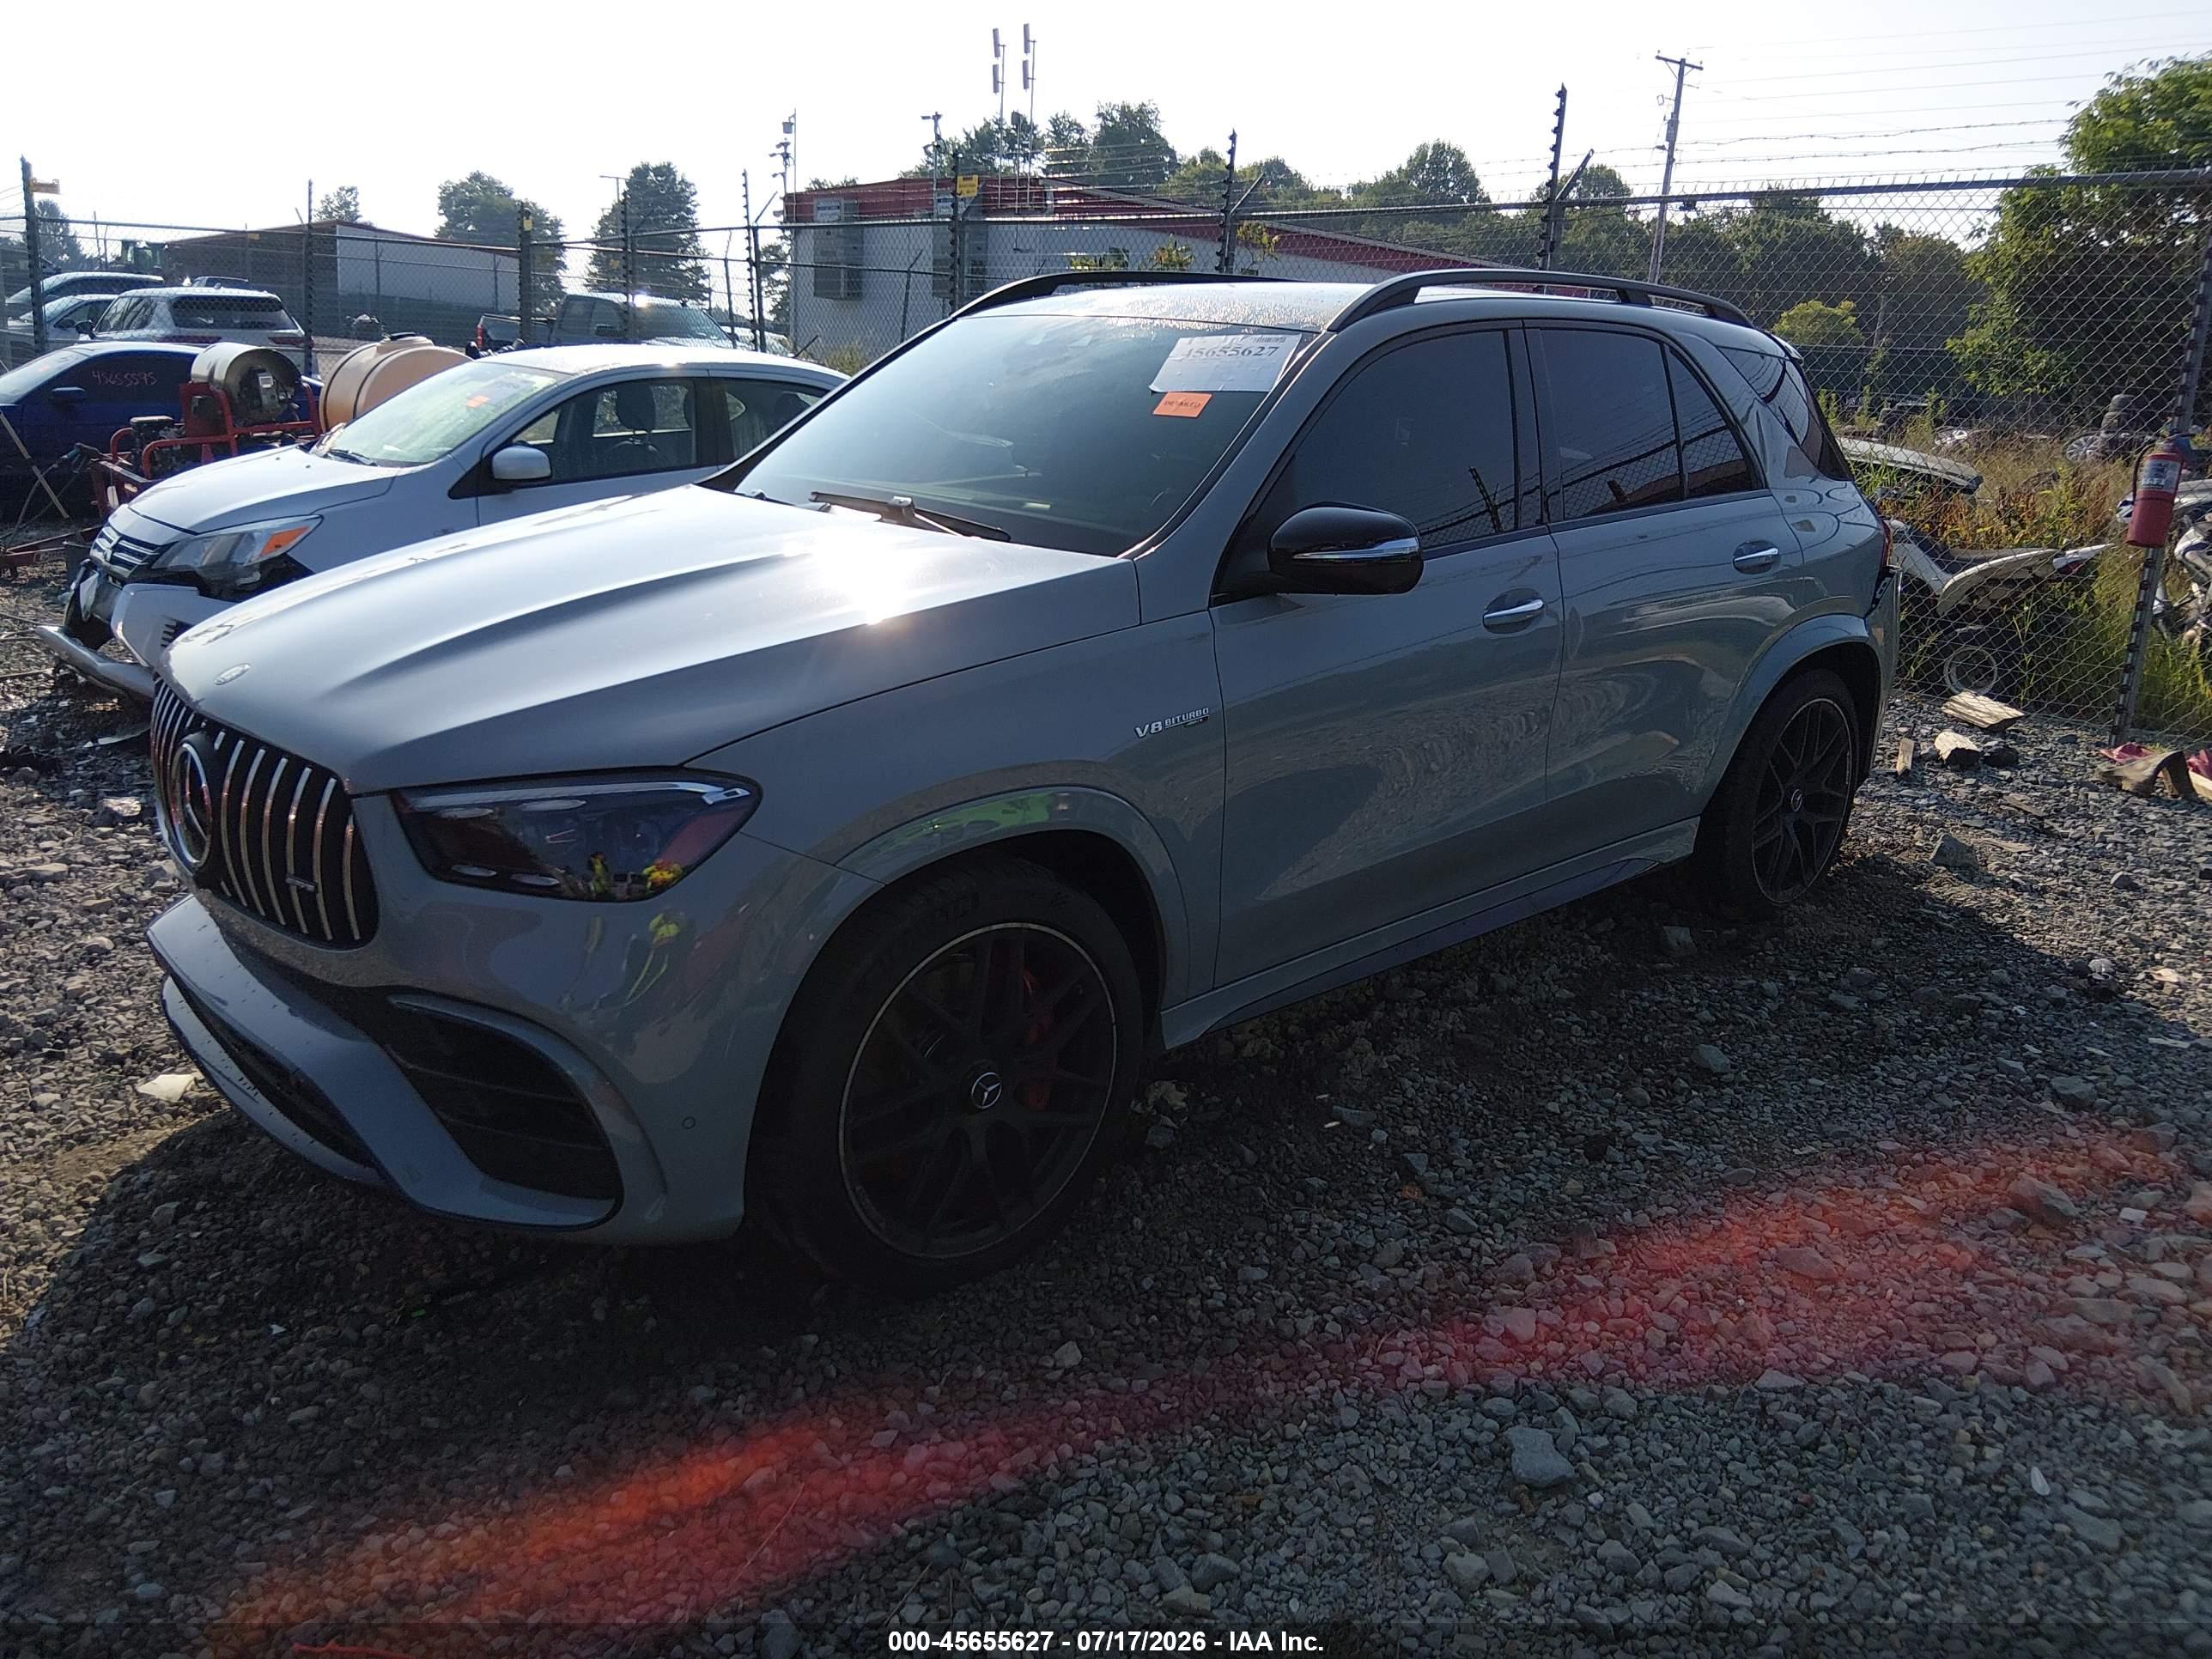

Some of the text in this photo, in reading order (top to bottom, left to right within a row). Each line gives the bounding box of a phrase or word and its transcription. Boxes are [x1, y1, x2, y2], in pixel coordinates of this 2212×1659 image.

[1182, 346, 1280, 358] 45655627
[1134, 720, 1163, 738] V8
[1164, 707, 1210, 727] BITURBO
